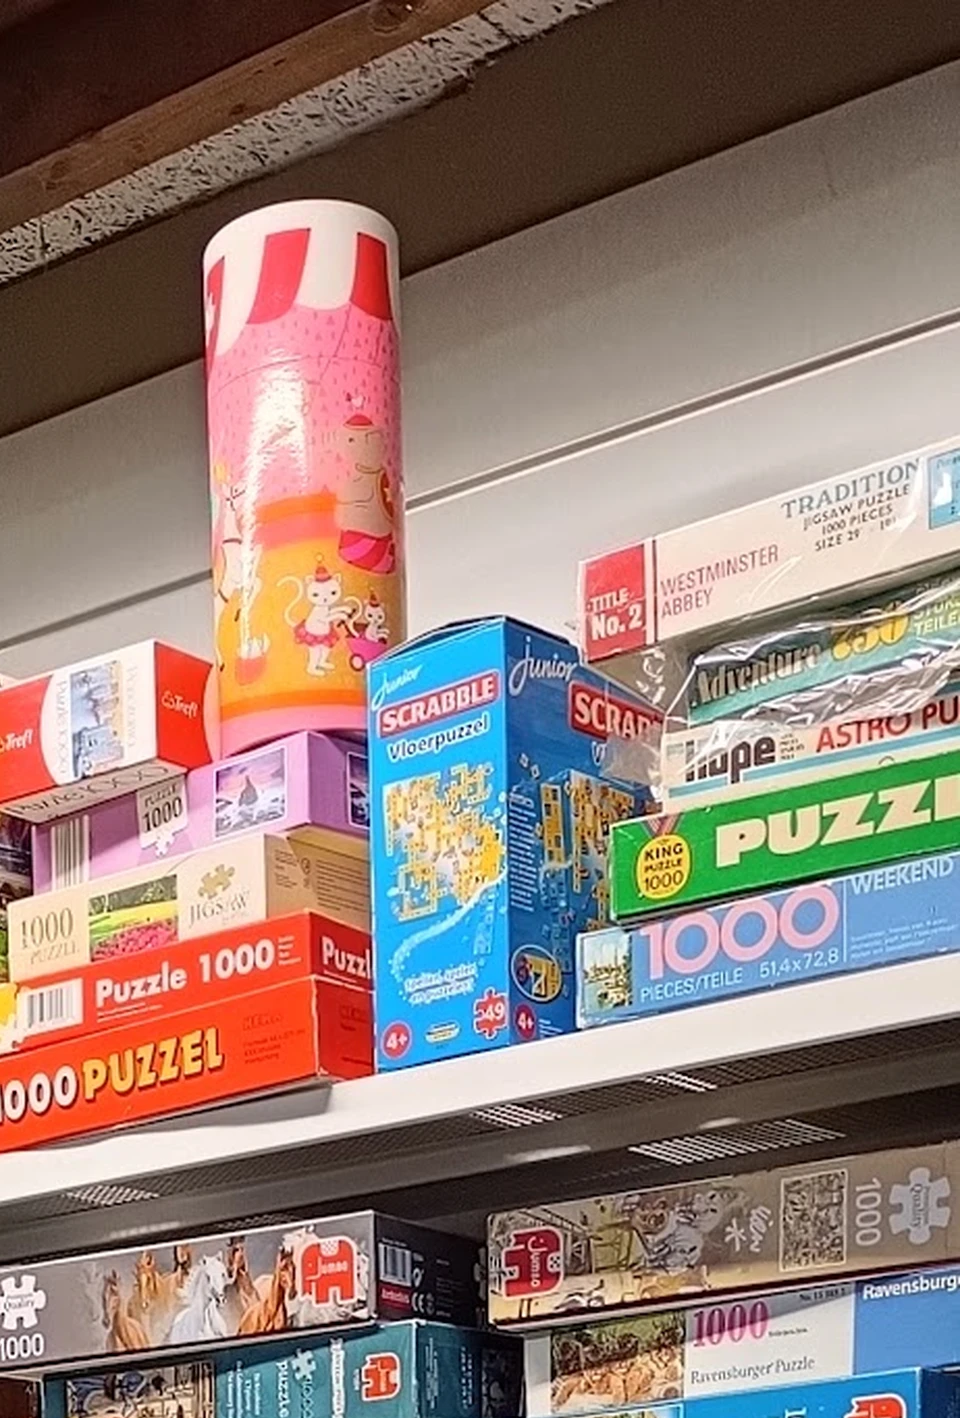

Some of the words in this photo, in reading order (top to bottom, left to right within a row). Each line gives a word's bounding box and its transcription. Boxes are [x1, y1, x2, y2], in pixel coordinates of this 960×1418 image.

[781, 457, 921, 519] TRADITION
[856, 483, 911, 511] PUZZLE
[660, 543, 780, 597] WESTMINSTER
[661, 587, 714, 619] ABBEY
[381, 674, 497, 732] SCRABBLE
[387, 714, 492, 764] Vloerpuzzel
[142, 797, 184, 832] 1000
[643, 858, 683, 874] PUZZLE
[644, 842, 684, 862] KING
[643, 870, 685, 894] 1000
[851, 856, 955, 896] WEEKEND
[20, 907, 74, 949] 1000
[640, 884, 841, 981] 1000
[95, 960, 189, 1008] Puzzle
[198, 938, 276, 984] 1000
[82, 1026, 226, 1100] PUZZEL
[855, 1177, 882, 1247] 1000
[692, 1300, 770, 1348] 1000
[775, 1355, 815, 1375] Puzzle
